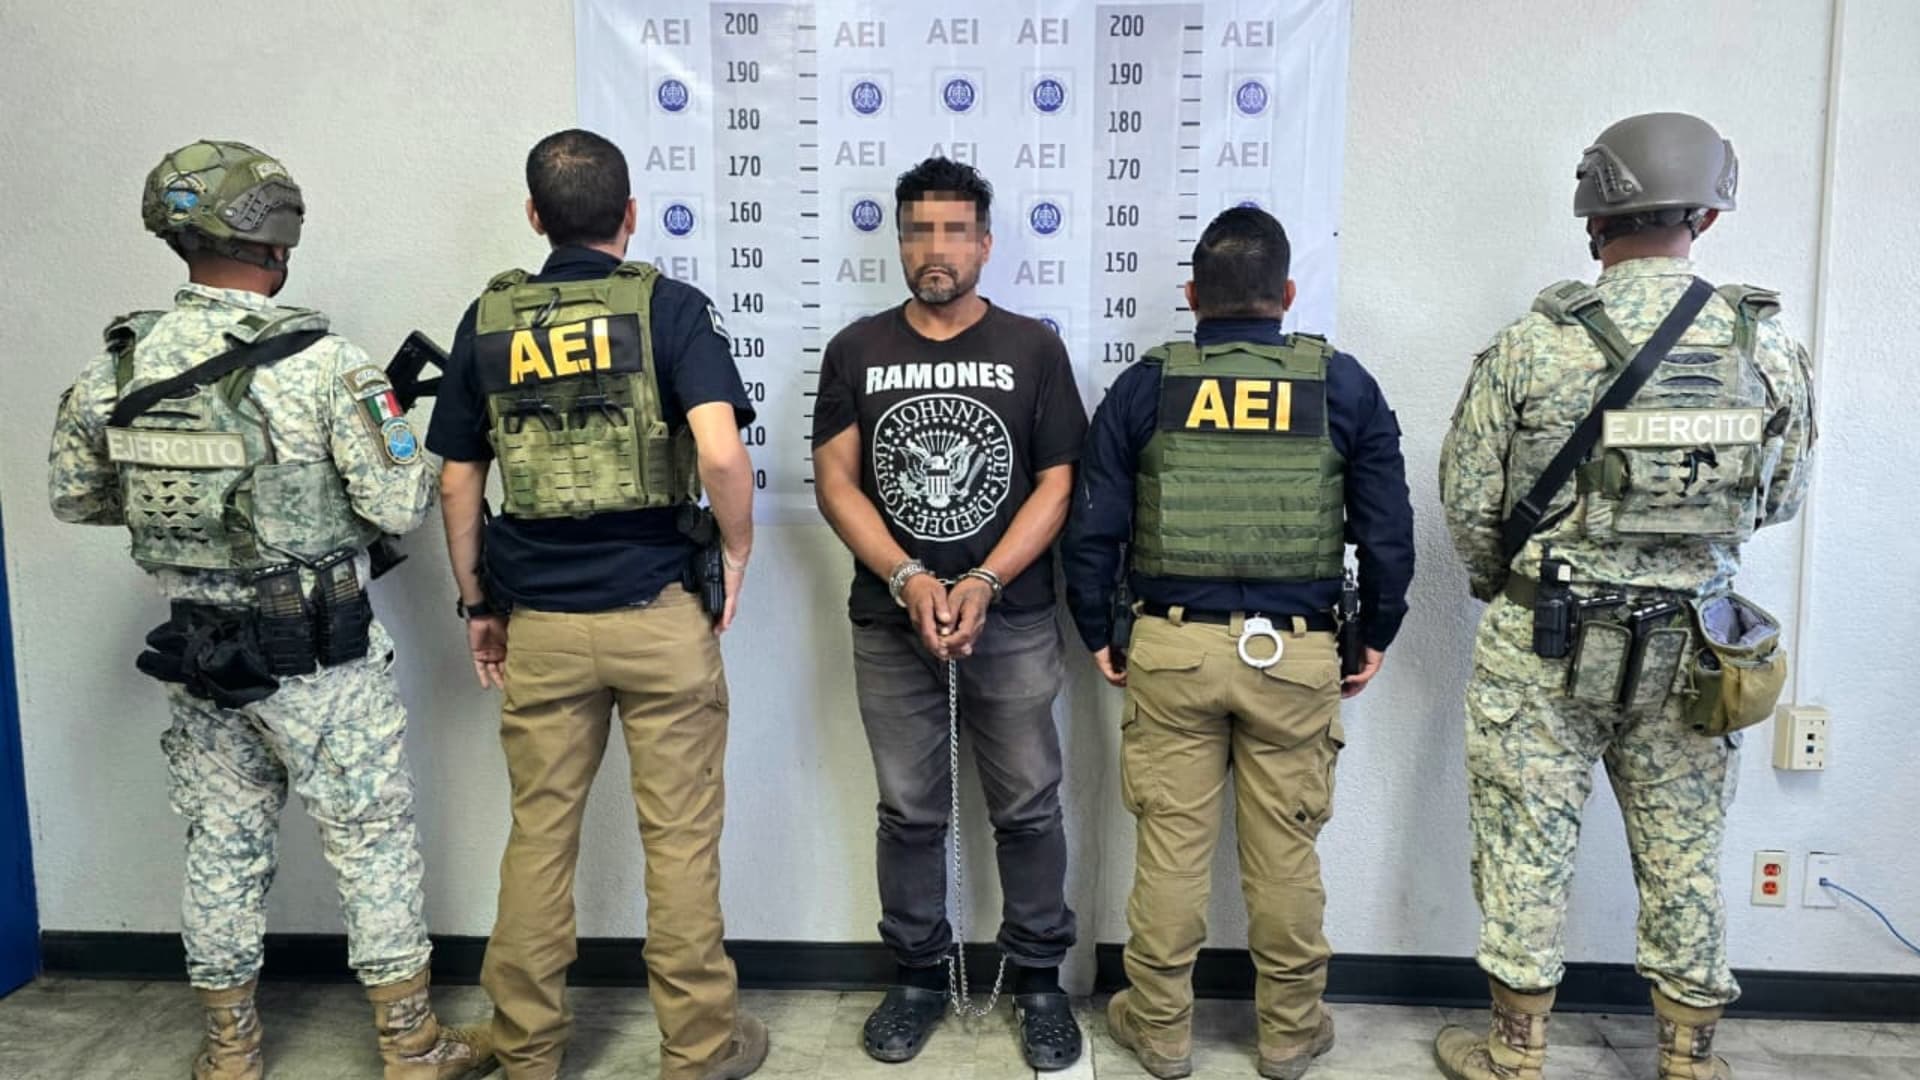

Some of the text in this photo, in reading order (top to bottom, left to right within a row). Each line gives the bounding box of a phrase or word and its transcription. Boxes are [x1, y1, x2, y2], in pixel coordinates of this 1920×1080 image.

[641, 19, 691, 45] AEI
[725, 13, 758, 35] 200
[834, 21, 885, 48] AEI
[927, 18, 979, 45] AEI
[1017, 18, 1069, 45] AEI
[1110, 15, 1144, 37] 200
[1221, 21, 1274, 47] AEI
[727, 61, 759, 83] 190
[1109, 63, 1143, 85] 190
[727, 109, 760, 130] 180
[1108, 111, 1142, 133] 180
[646, 146, 696, 171] AEI
[834, 141, 886, 167] AEI
[1014, 143, 1066, 168] AEI
[1216, 142, 1269, 167] AEI
[728, 156, 761, 177] 170
[1107, 159, 1141, 180] 170
[729, 202, 762, 223] 160
[1106, 205, 1139, 227] 160
[731, 248, 763, 269] 150
[1105, 252, 1138, 273] 150
[836, 258, 886, 283] AEI
[1015, 260, 1065, 285] AEI
[731, 293, 764, 313] 140
[1103, 298, 1137, 318] 140
[510, 317, 612, 385] AEI
[733, 338, 765, 358] 130
[1103, 344, 1135, 363] 130
[865, 361, 1015, 395] RAMONES
[744, 382, 765, 402] 20
[891, 399, 991, 431] JOHNNY
[1184, 379, 1293, 431] AEI
[745, 426, 766, 446] 10
[986, 435, 1009, 488] JOEY
[876, 437, 911, 520] TOMMY
